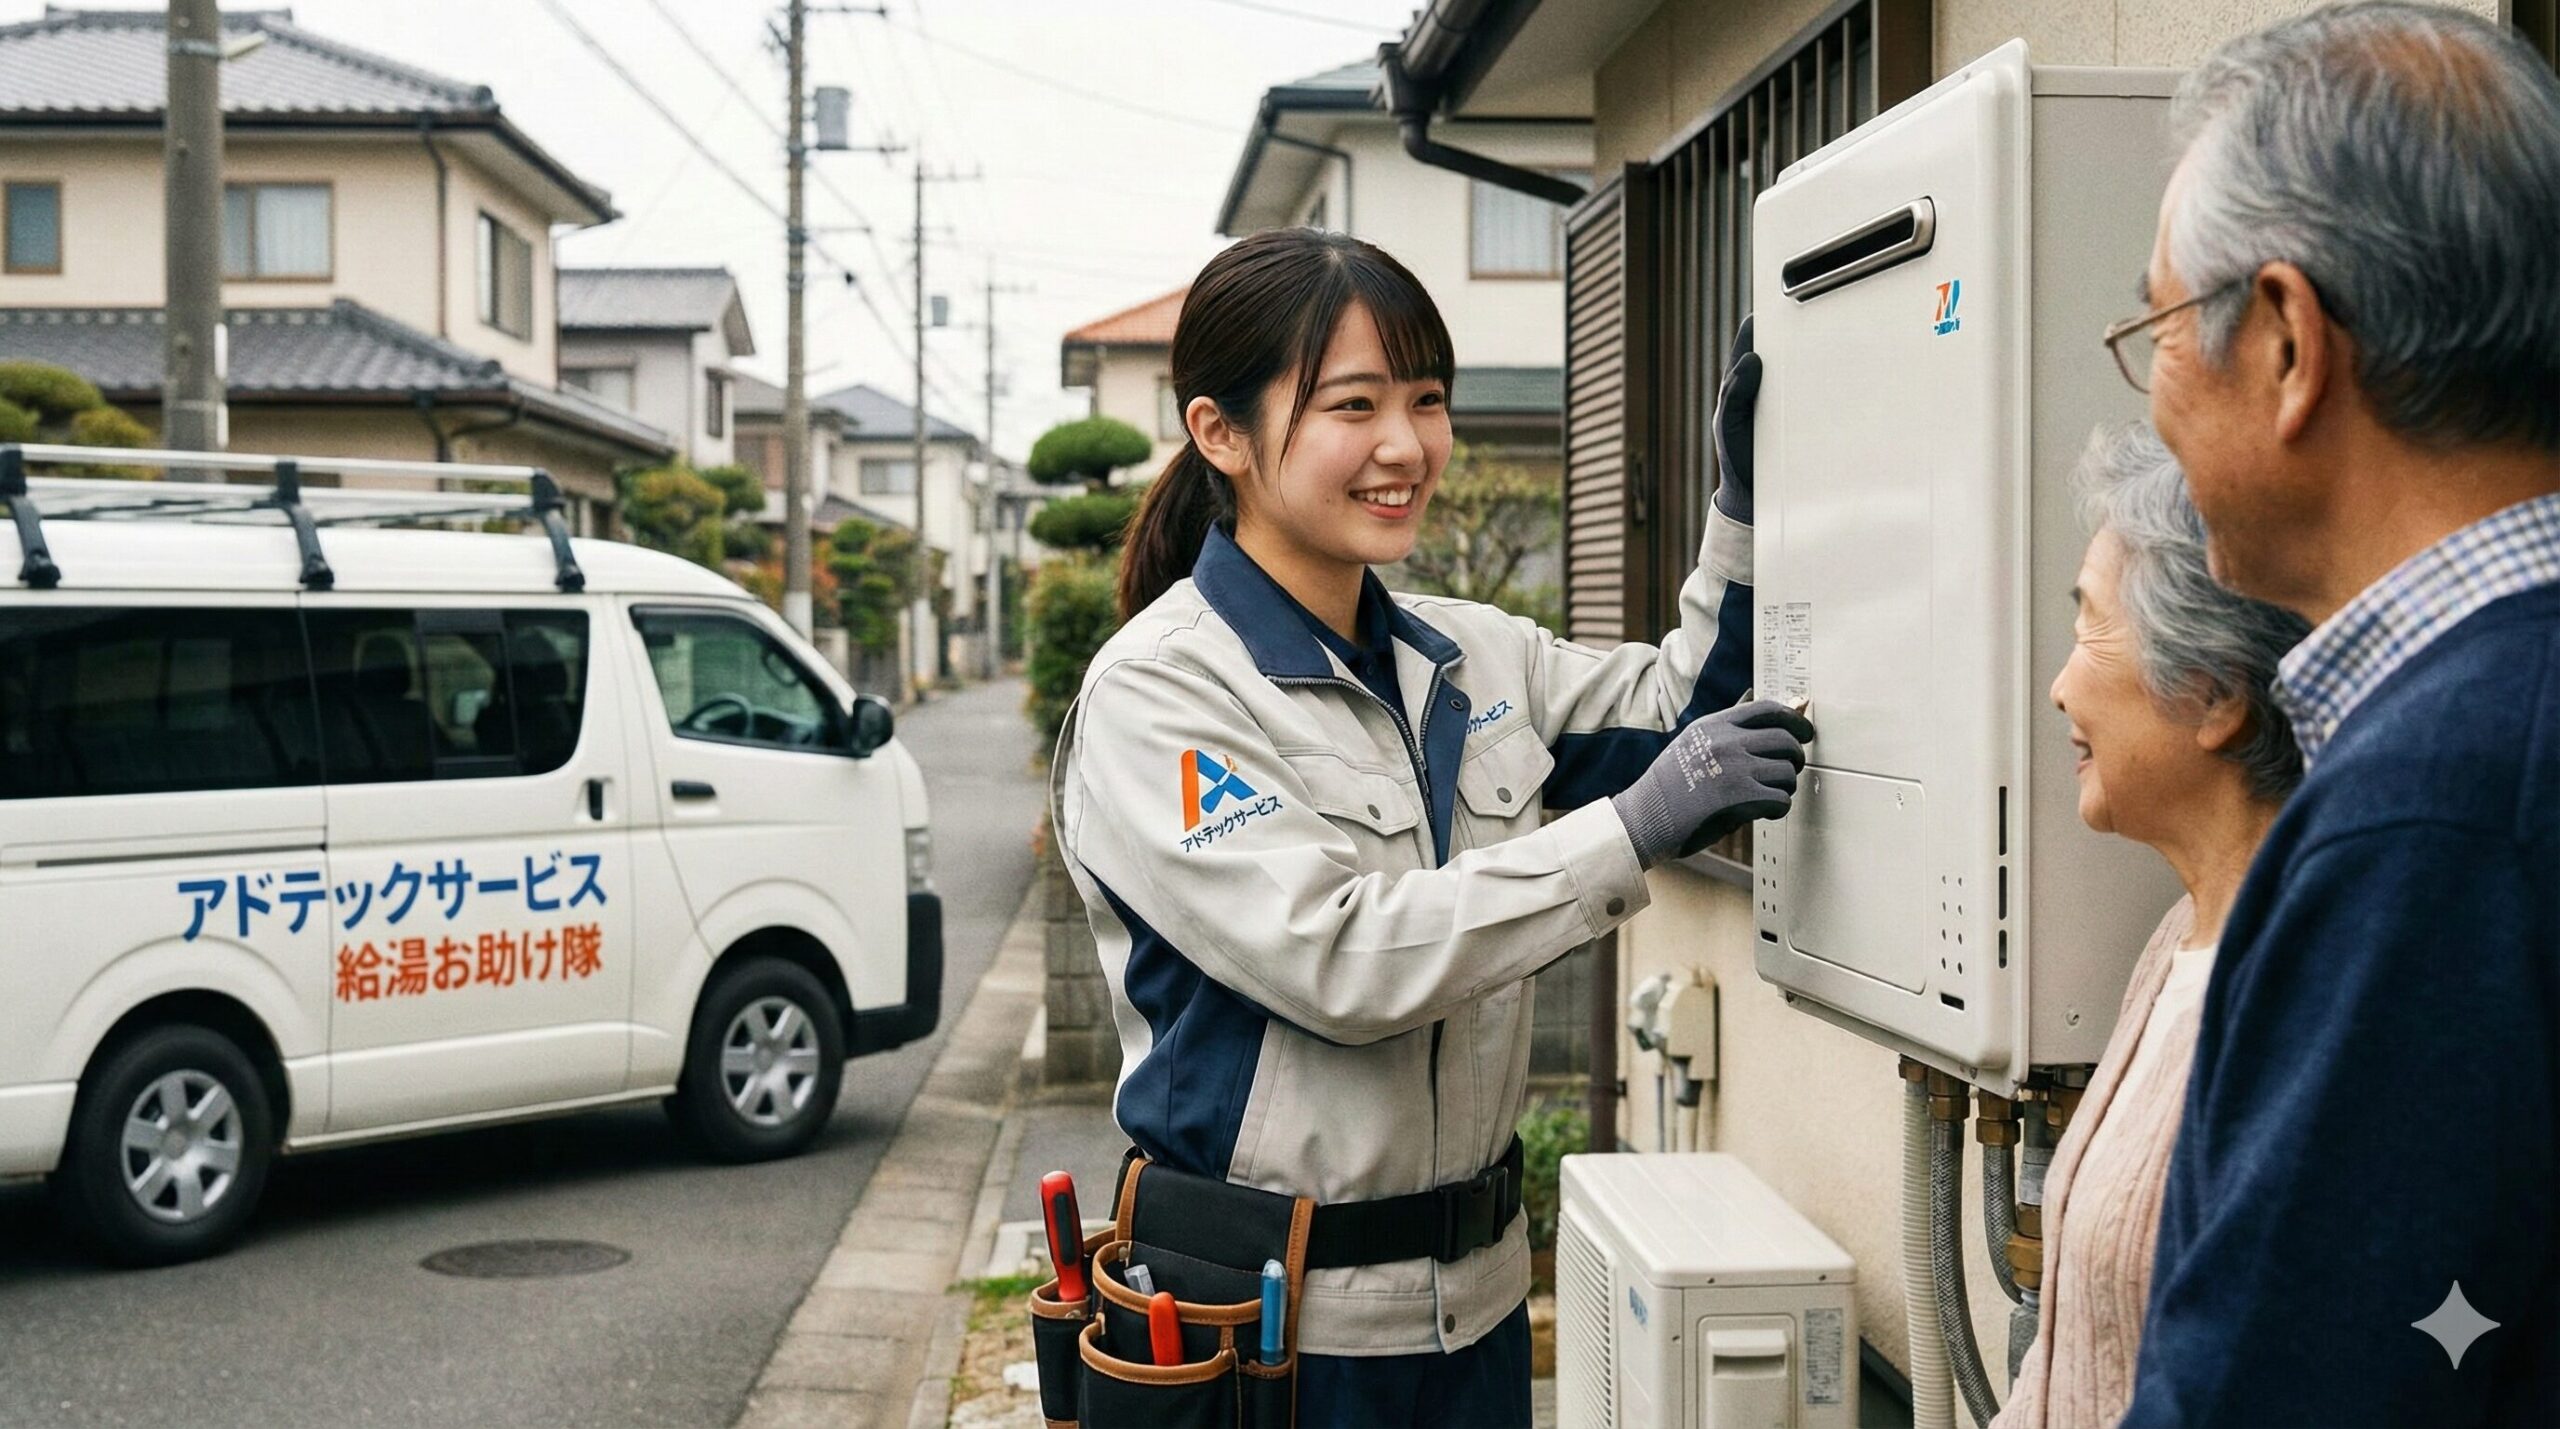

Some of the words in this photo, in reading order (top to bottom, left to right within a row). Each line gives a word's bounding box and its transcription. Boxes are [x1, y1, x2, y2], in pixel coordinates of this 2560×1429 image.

[1180, 795, 1283, 853] アドテックサービス
[177, 850, 607, 942] アドテックサービス
[336, 922, 603, 1003] 給湯お助け隊
